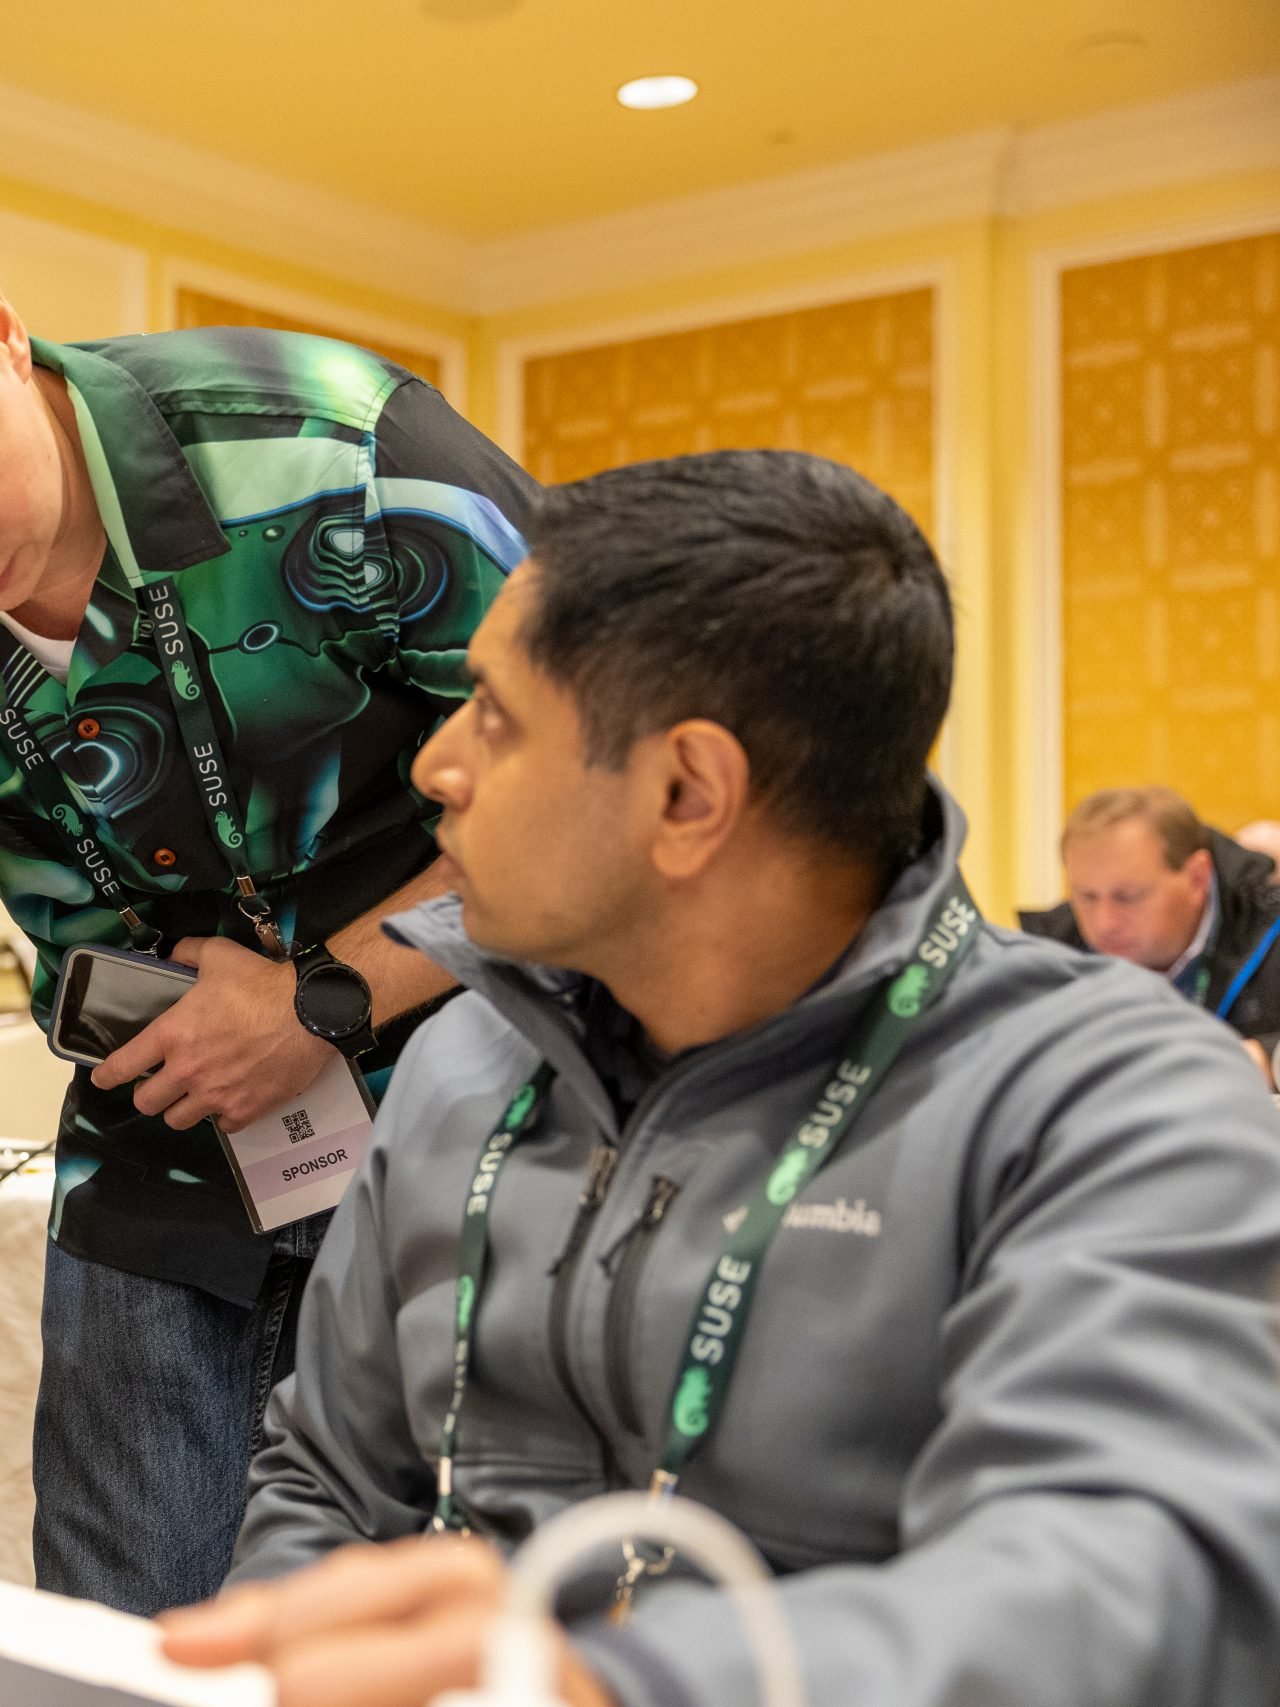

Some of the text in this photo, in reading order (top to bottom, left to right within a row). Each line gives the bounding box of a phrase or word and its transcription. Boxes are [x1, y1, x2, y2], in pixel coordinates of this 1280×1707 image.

[149, 585, 185, 656] SUSE
[194, 742, 228, 808] SUSE
[76, 838, 121, 898] SUSE
[920, 896, 976, 969] SUSE
[799, 1059, 871, 1149] SUSE
[282, 1148, 349, 1182] SPONSOR
[467, 1131, 514, 1216] SUSE
[691, 1255, 752, 1365] SUSE
